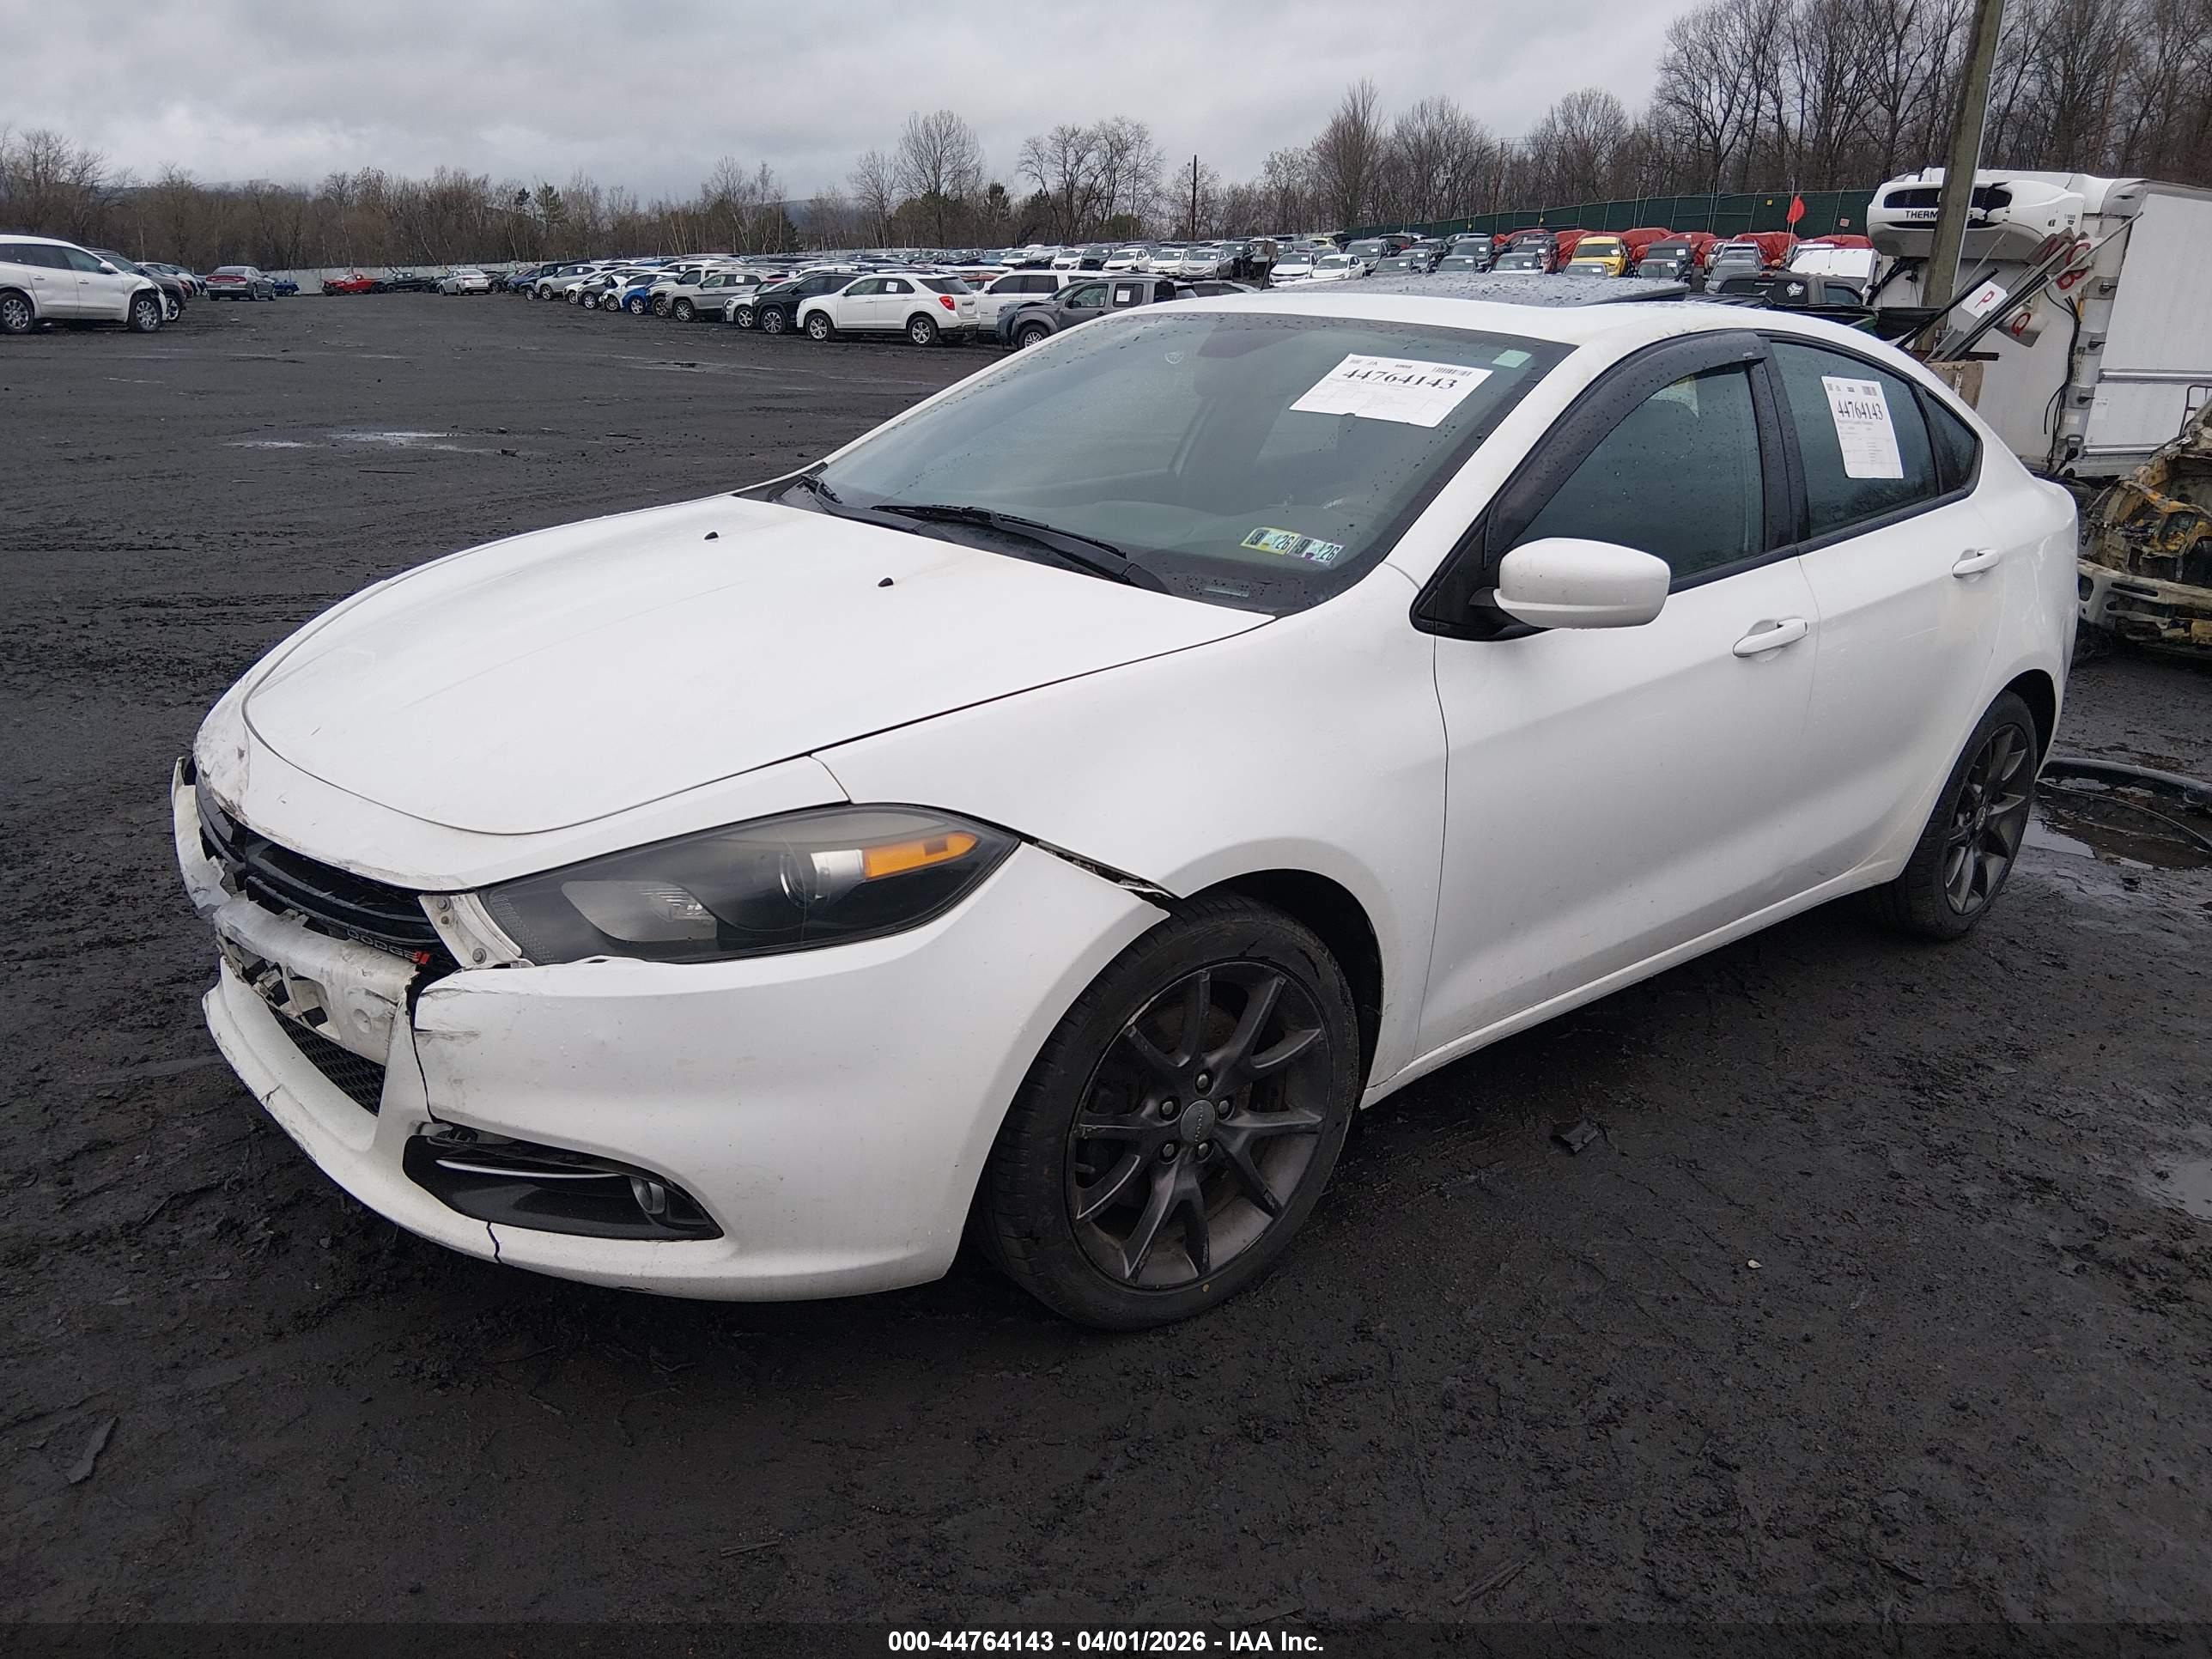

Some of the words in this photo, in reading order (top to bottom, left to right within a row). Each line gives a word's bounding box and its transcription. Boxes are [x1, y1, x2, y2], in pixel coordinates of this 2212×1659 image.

[1905, 210, 1938, 220] THERM
[1974, 289, 1996, 309] P
[2010, 311, 2032, 337] Q
[1342, 368, 1458, 390] 44764143
[1837, 399, 1884, 421] 44764143
[1275, 534, 1295, 550] 26
[1318, 545, 1340, 562] 26
[346, 928, 419, 962] DODGE
